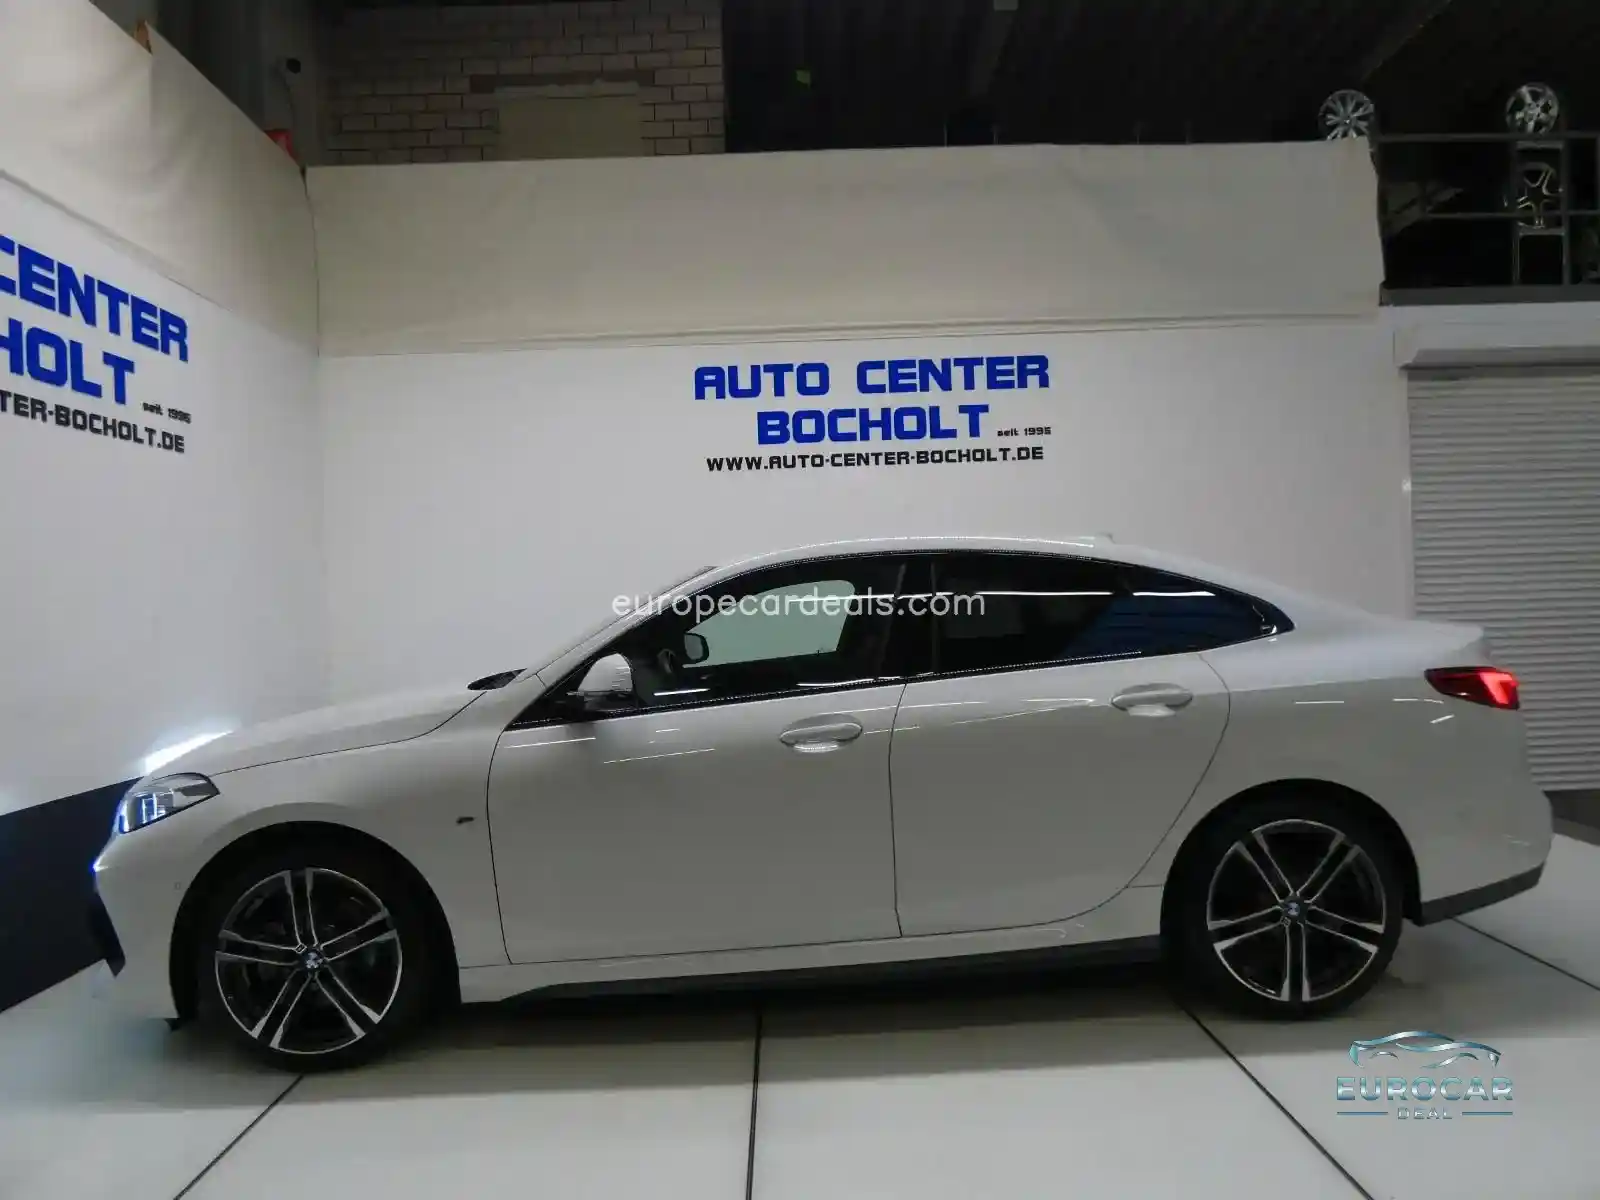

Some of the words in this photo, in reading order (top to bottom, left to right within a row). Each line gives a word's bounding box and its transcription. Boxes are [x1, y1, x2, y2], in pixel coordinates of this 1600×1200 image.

[694, 362, 830, 400] AUTO
[856, 354, 1050, 394] CENTER
[757, 404, 990, 445] BOCHOLT
[997, 427, 1019, 437] seit
[706, 446, 1045, 472] WWW.AUTO-CENTER-BOCHOLT.DE
